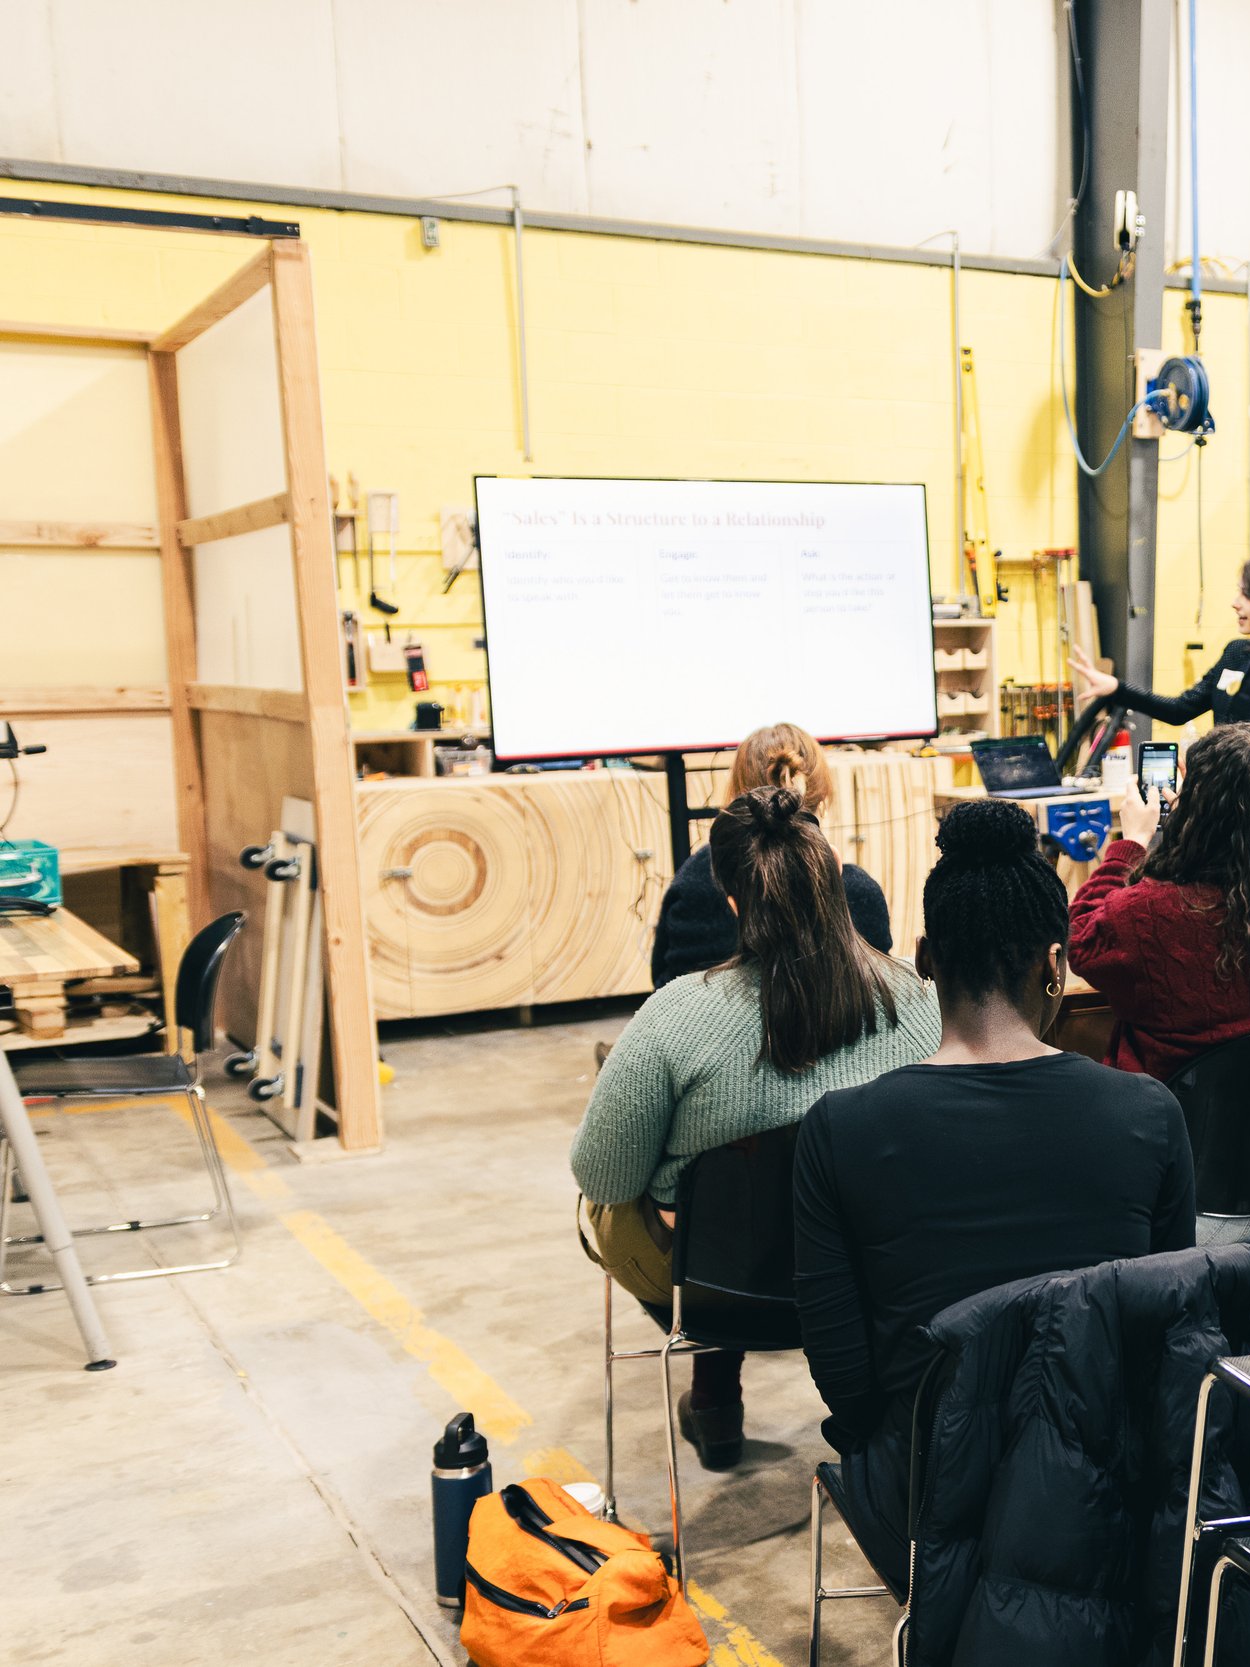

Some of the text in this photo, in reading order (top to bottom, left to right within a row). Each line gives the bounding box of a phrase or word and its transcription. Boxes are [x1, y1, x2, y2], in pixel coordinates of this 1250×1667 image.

[571, 511, 587, 525] Is
[592, 514, 601, 525] a
[607, 510, 686, 526] Structure
[692, 511, 707, 526] to
[711, 514, 721, 526] a
[727, 508, 825, 529] Relationship
[504, 549, 551, 560] Identify:
[658, 549, 698, 561] Engage:
[506, 575, 548, 586] Identify
[693, 573, 720, 583] know
[722, 573, 748, 583] them
[750, 573, 768, 583] and
[677, 590, 702, 600] them
[734, 589, 761, 599] know
